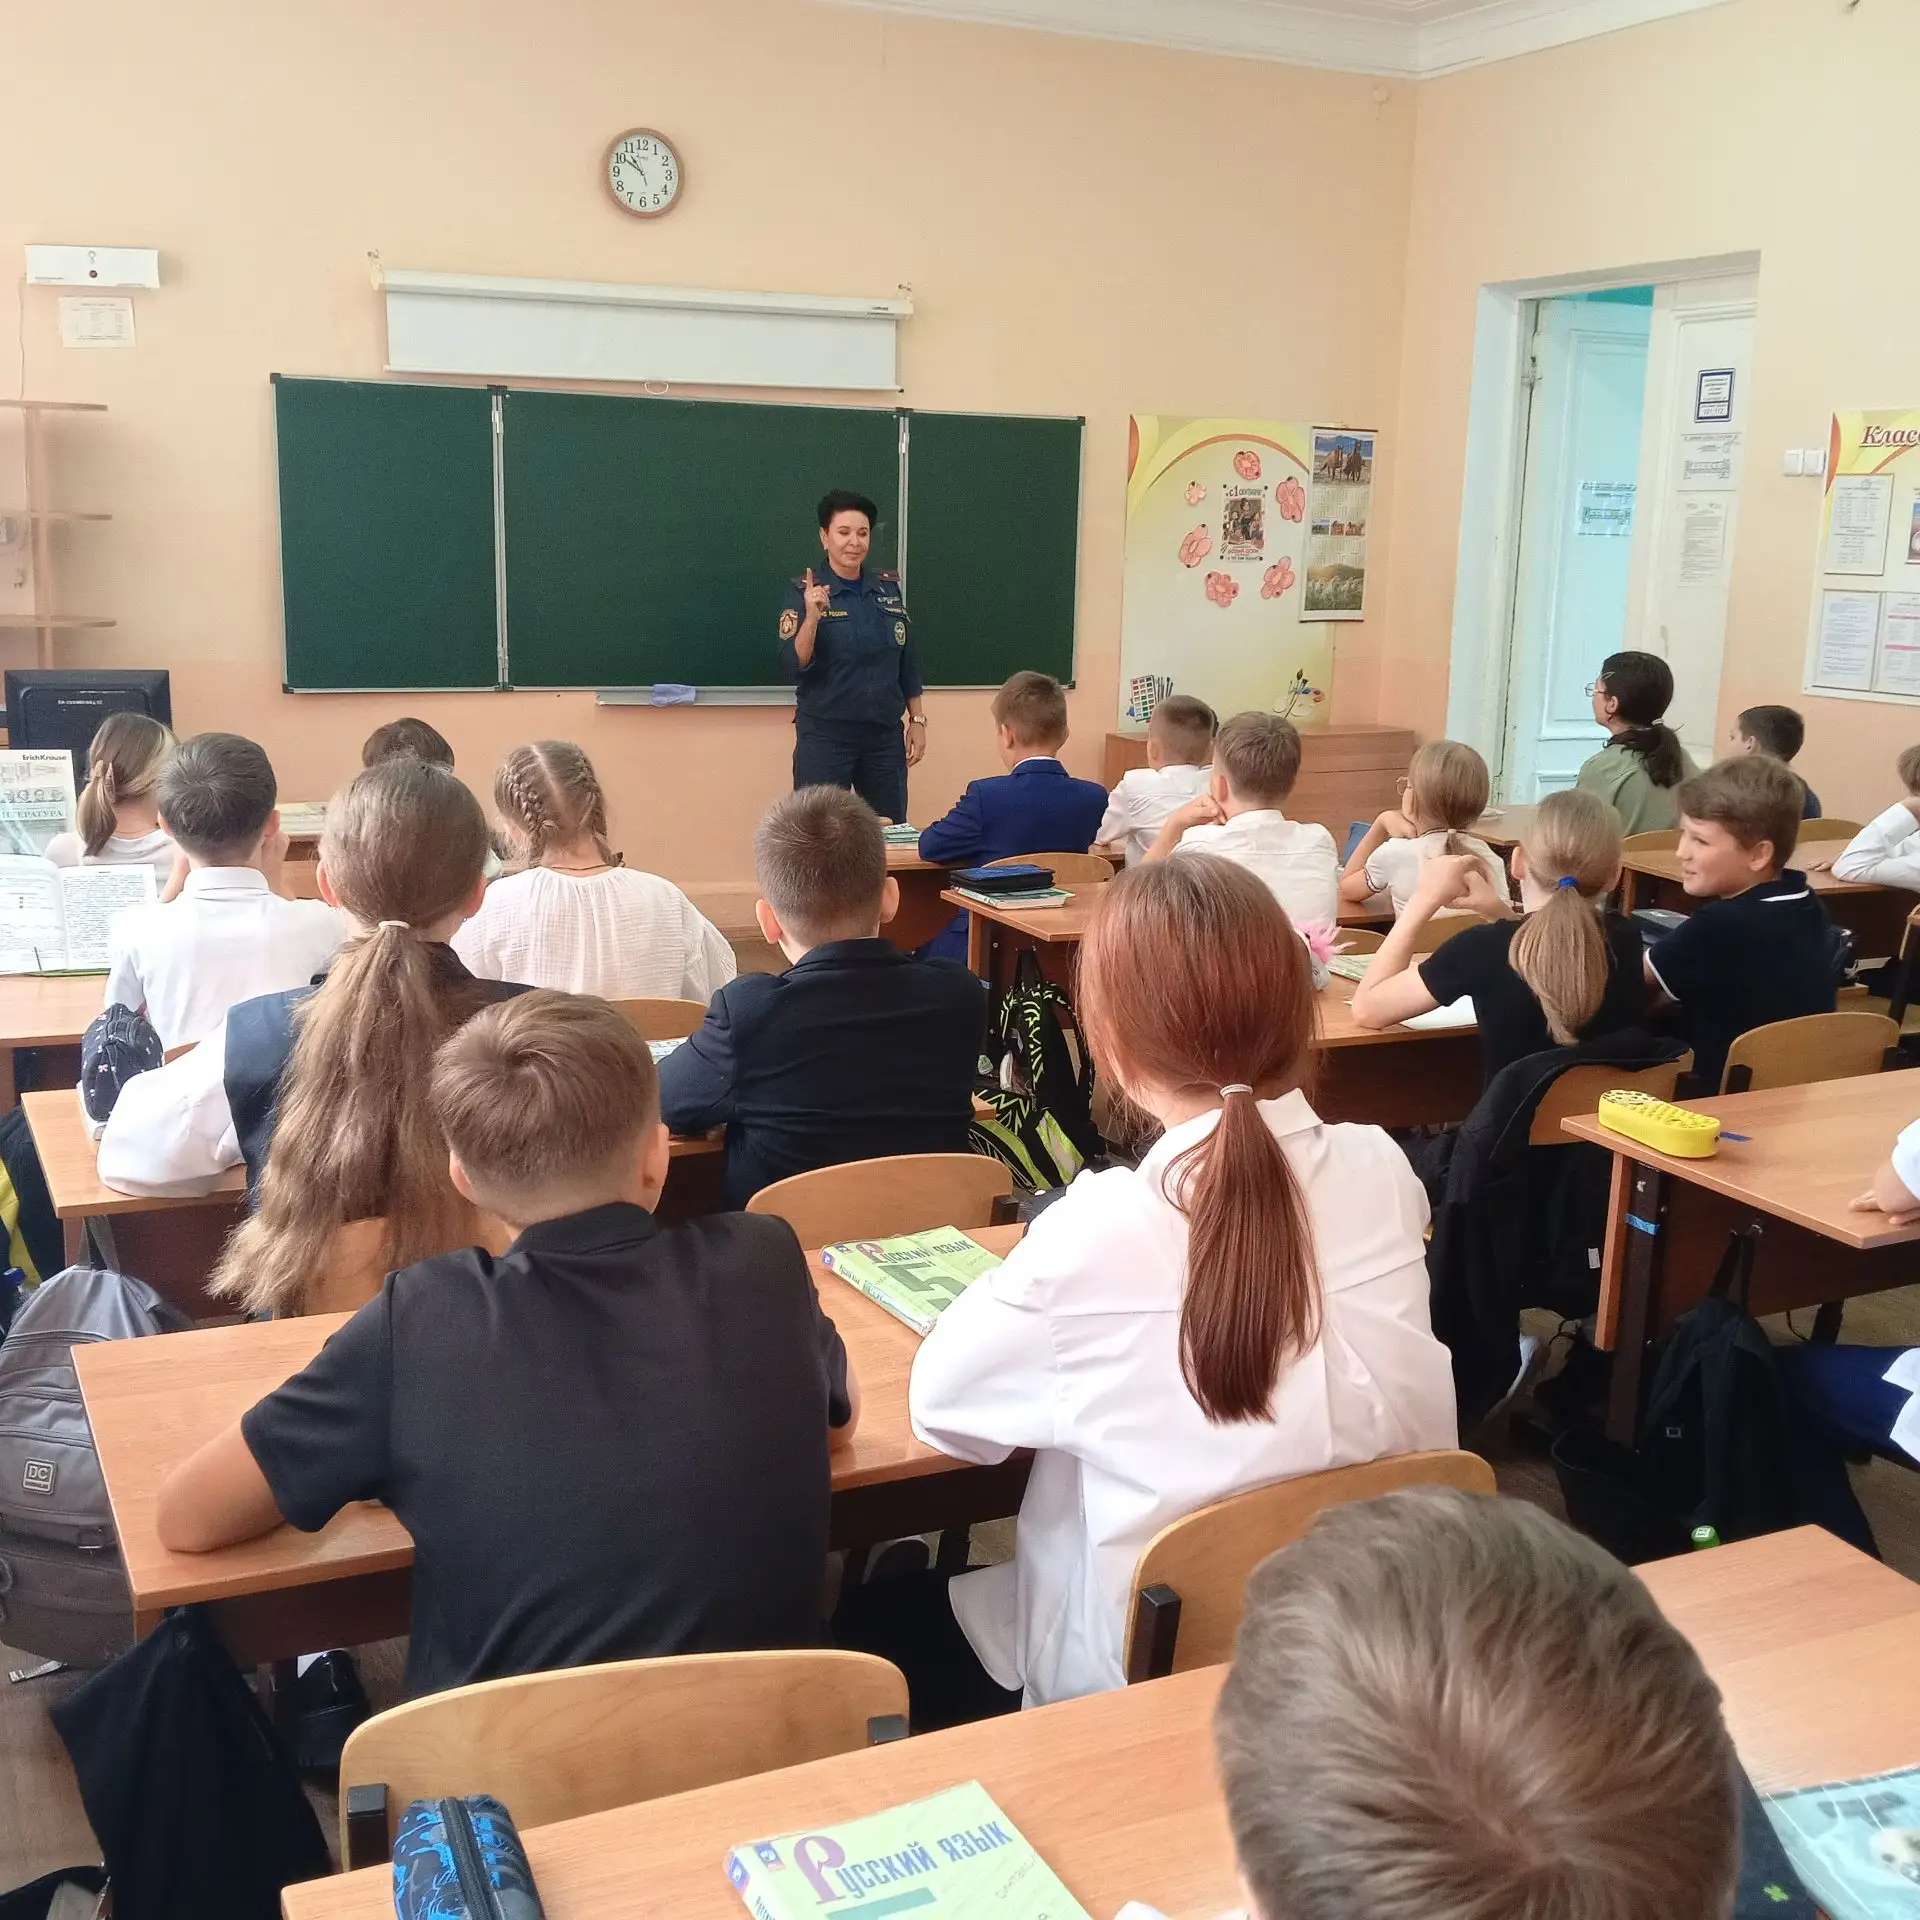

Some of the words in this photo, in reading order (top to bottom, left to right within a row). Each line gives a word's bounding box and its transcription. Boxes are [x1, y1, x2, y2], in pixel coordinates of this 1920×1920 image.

[624, 142, 635, 153] 11
[636, 139, 649, 151] 12
[653, 144, 658, 155] 1
[615, 152, 626, 164] 10
[661, 155, 669, 166] 2
[613, 166, 620, 177] 9
[665, 170, 672, 181] 3
[616, 181, 624, 192] 8
[661, 184, 668, 195] 4
[627, 192, 634, 203] 7
[639, 196, 647, 207] 6
[653, 194, 660, 205] 5
[1861, 425, 1920, 445] Клас
[856, 1242, 932, 1265] Русский
[28, 1465, 49, 1479] DC
[793, 1835, 938, 1905] Русский
[936, 1820, 1013, 1862] язык
